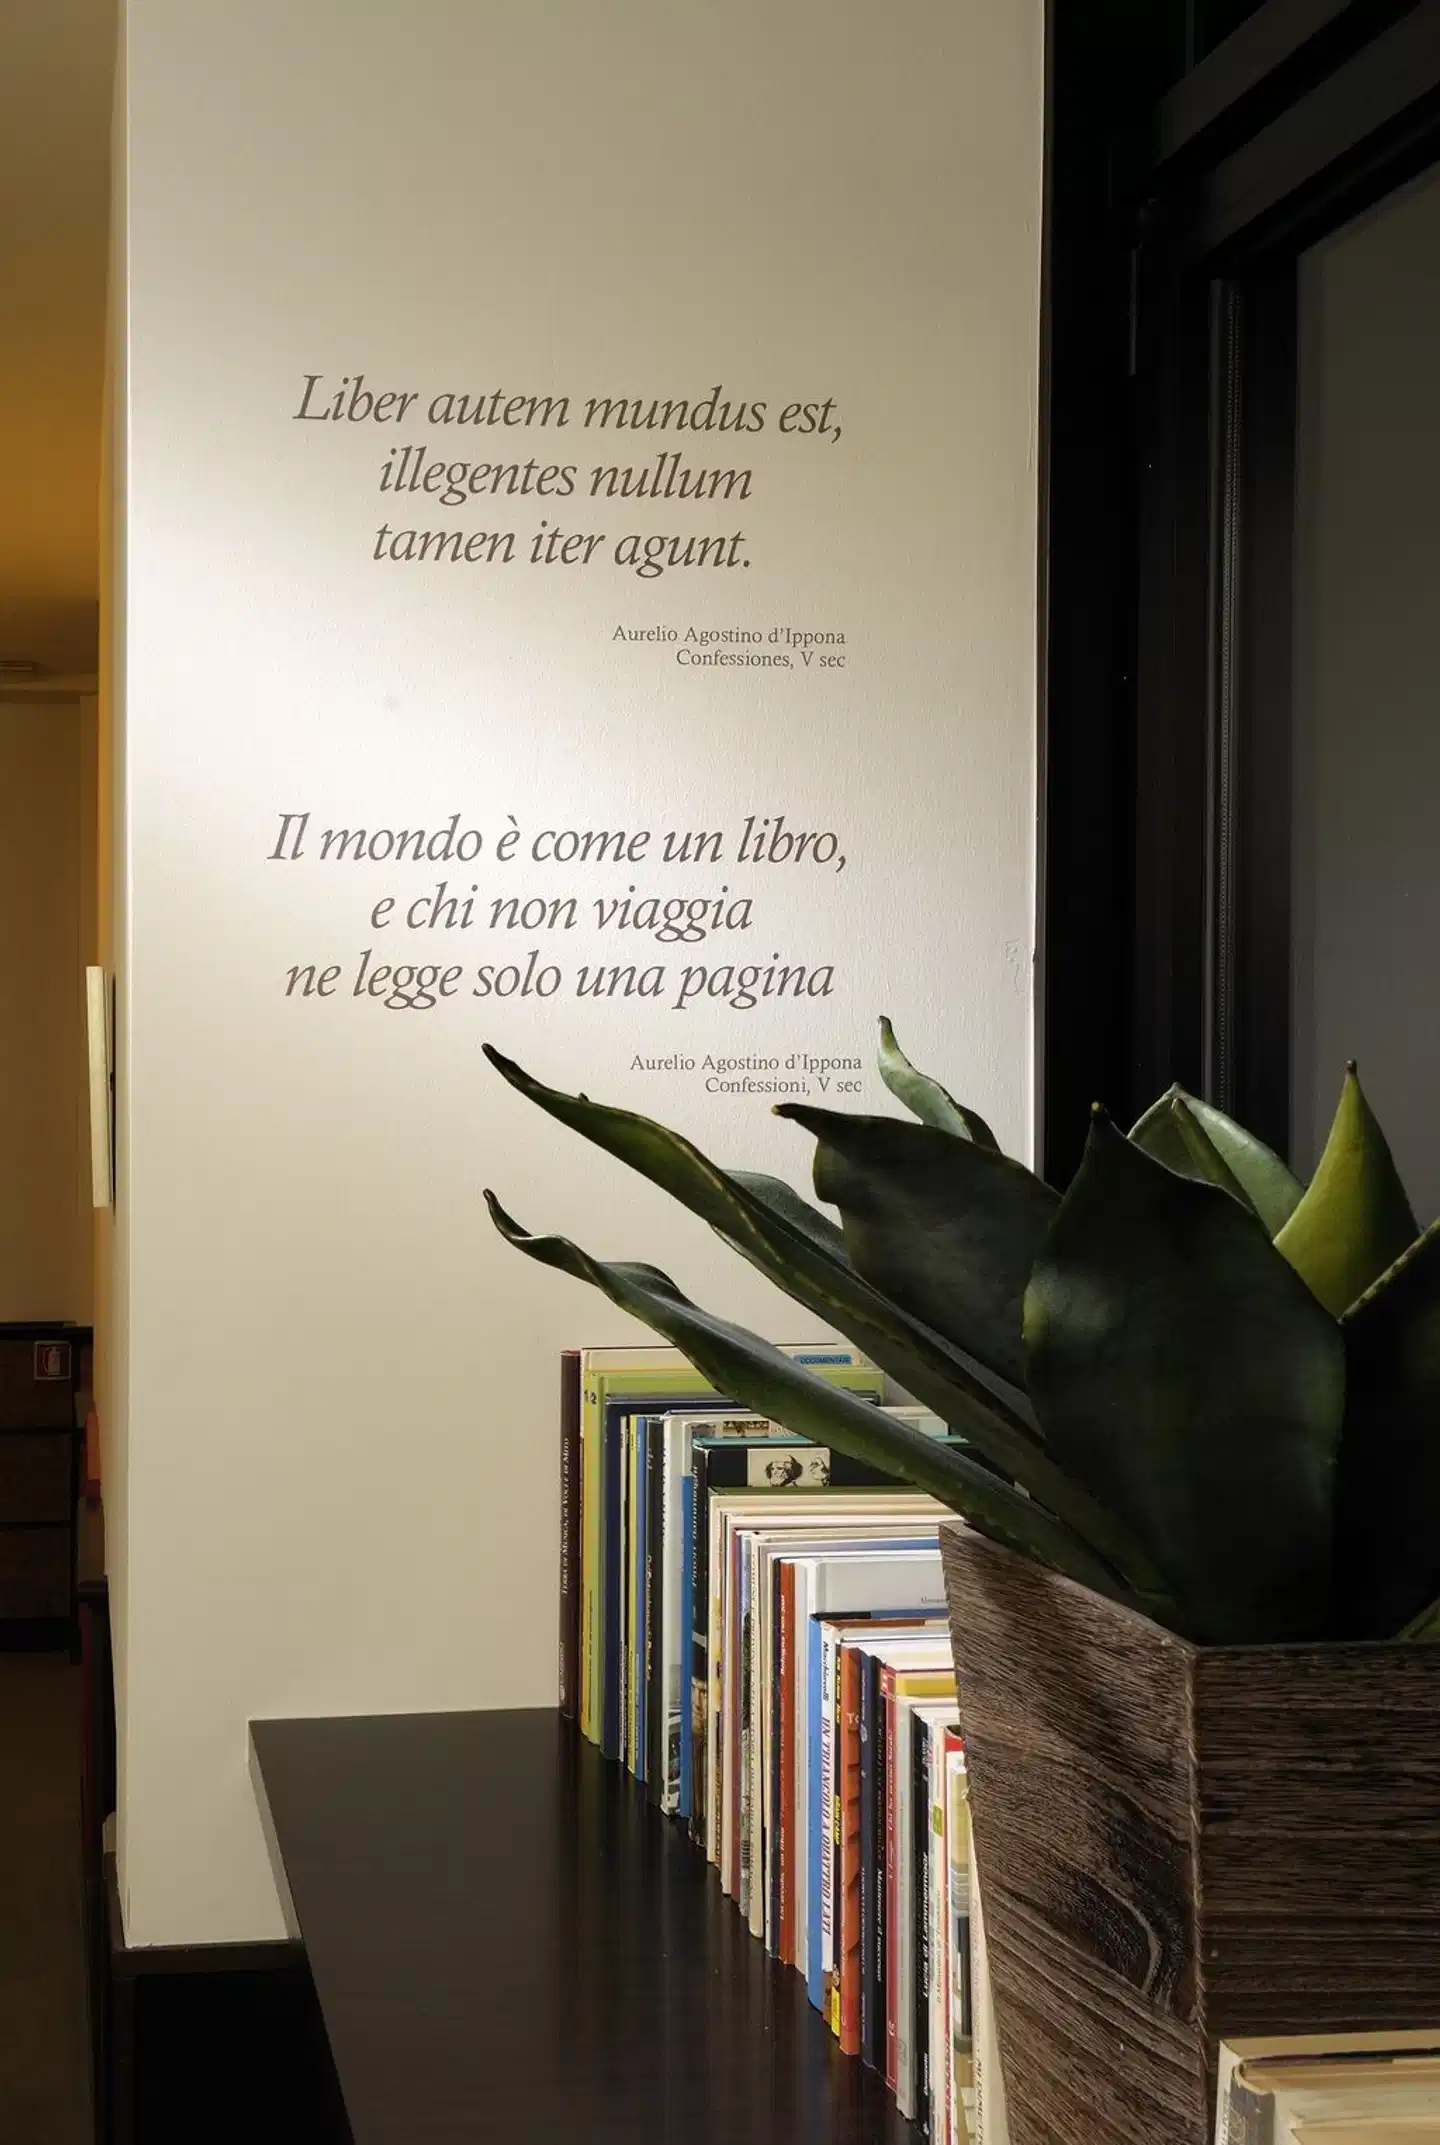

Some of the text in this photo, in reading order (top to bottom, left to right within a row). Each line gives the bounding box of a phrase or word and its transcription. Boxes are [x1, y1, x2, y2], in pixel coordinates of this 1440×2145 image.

[292, 374, 842, 445] Liber autem mundus est,
[379, 444, 753, 507] illegentes nullum
[372, 519, 751, 579] tamen iter agunt.
[611, 624, 846, 649] Aurelio Agostino d'Ippona
[676, 648, 846, 670] Confessiones, V sec
[266, 812, 847, 874] Il mondo è come un libro,
[370, 880, 754, 944] e chi non viaggia
[284, 947, 835, 1011] ne legge solo una pagina
[629, 1053, 863, 1075] Aurelio Agostino d'Ippona
[704, 1075, 863, 1097] Confessioni, V sec
[821, 1716, 831, 1734] UN
[876, 1868, 884, 1924] Mantenere
[921, 1961, 929, 1998] Lucia
